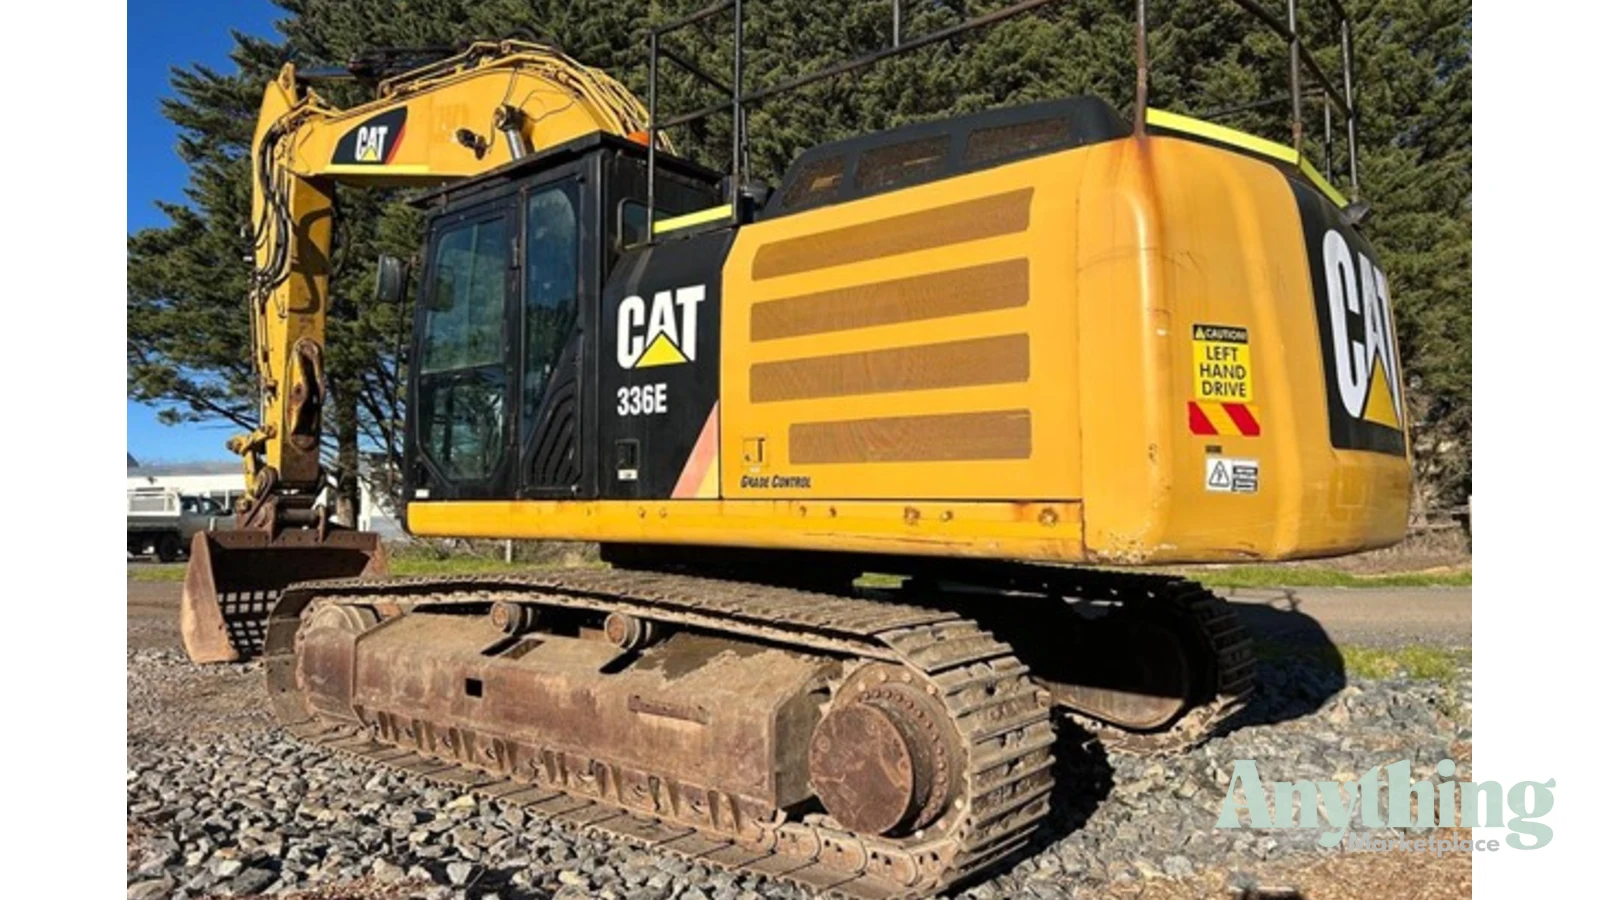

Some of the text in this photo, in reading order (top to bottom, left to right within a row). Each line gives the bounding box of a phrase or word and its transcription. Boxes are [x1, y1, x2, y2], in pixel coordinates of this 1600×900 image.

[354, 126, 388, 161] CAT
[617, 285, 706, 369] CAT
[1206, 346, 1239, 361] LEFT
[1200, 364, 1246, 380] HAND
[617, 383, 668, 416] 336E
[1202, 381, 1246, 397] DRIVE
